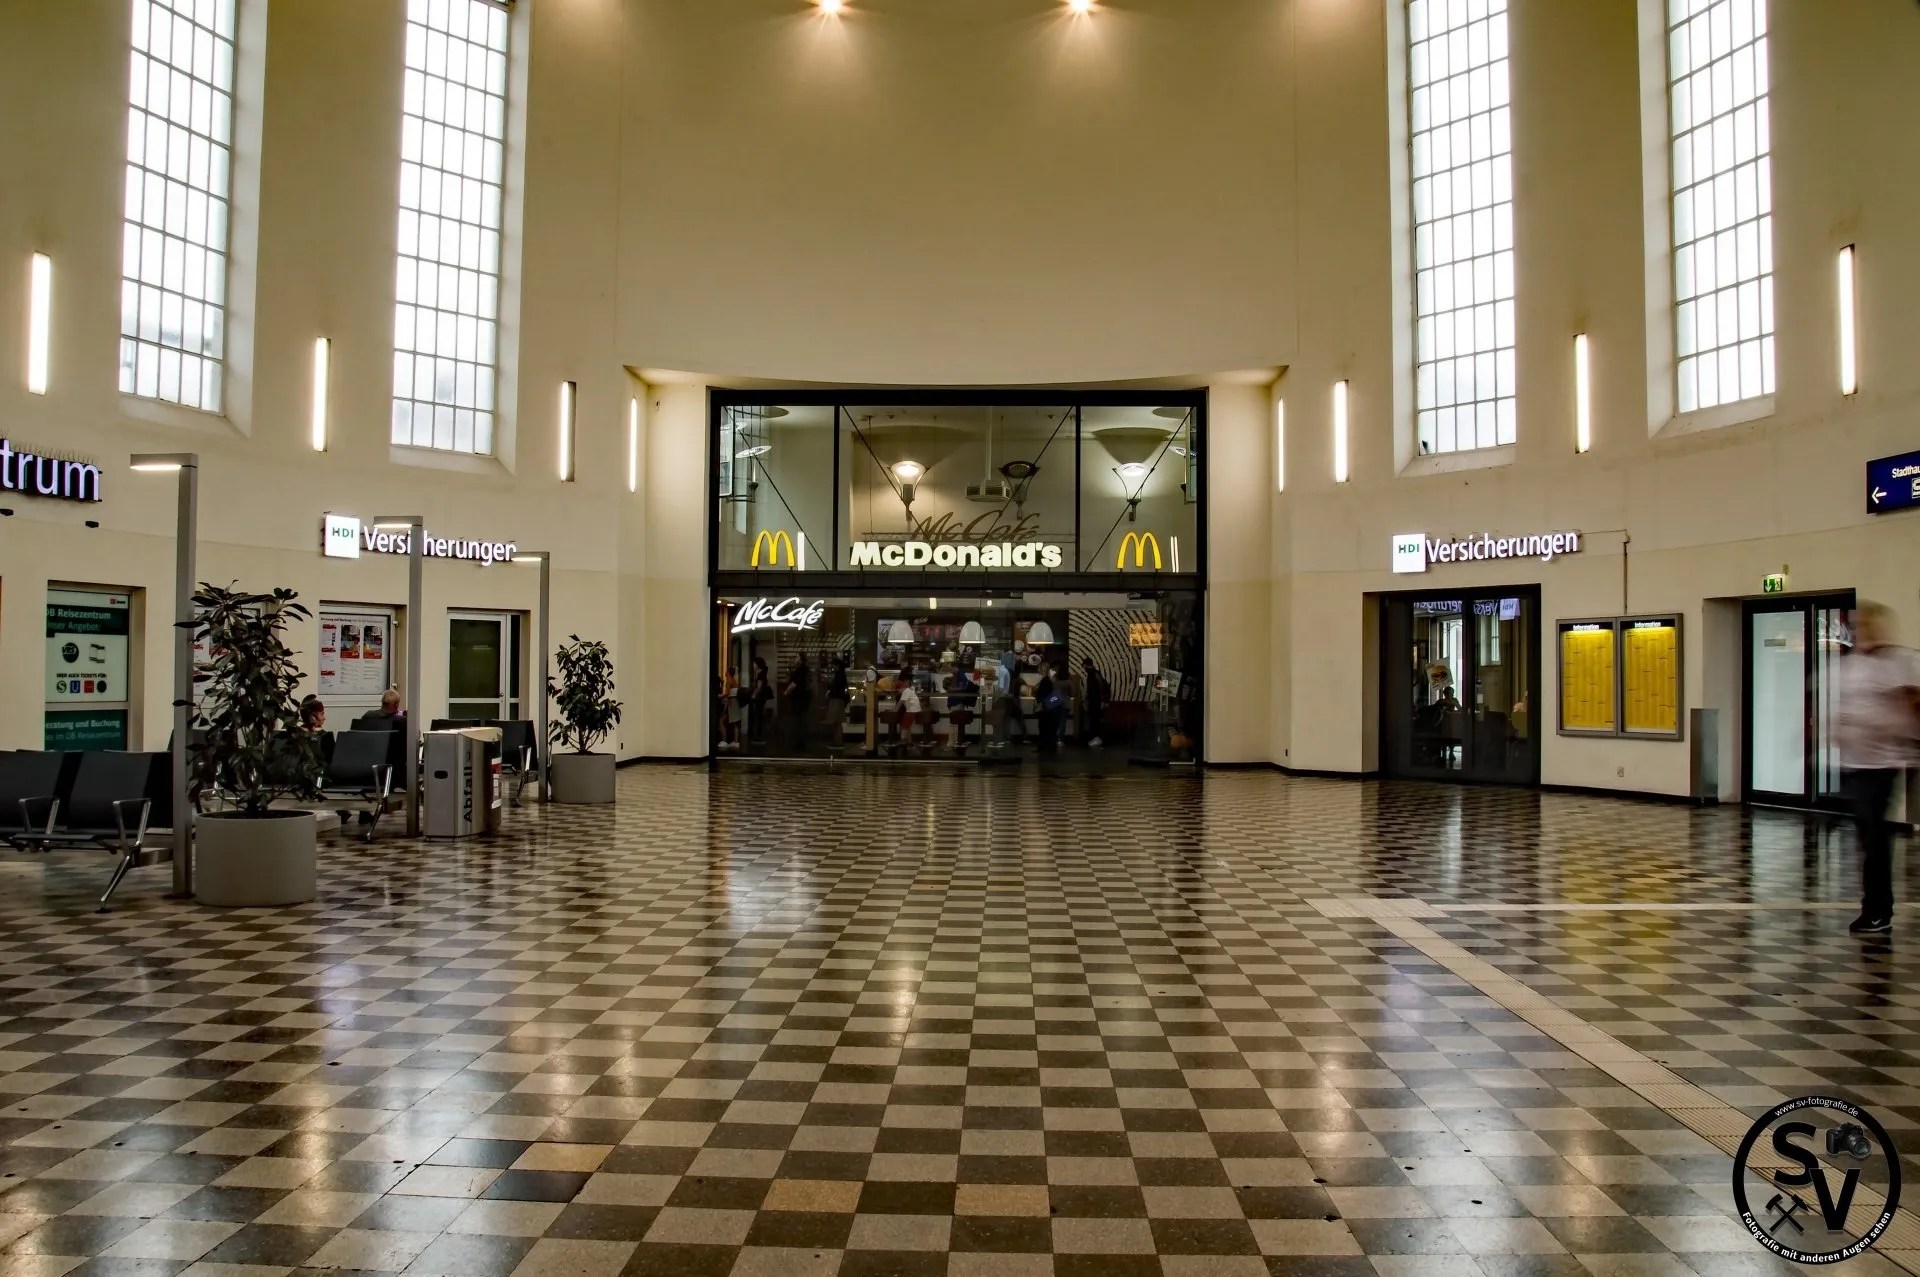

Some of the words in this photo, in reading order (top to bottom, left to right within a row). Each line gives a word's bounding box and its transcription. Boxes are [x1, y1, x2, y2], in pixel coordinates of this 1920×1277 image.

[0, 439, 99, 501] trum
[332, 526, 354, 539] HDI
[364, 525, 517, 567] Versiherungen
[850, 541, 1063, 568] McDonald's
[1398, 543, 1420, 554] HDI
[1426, 532, 1578, 562] Versicherungen
[57, 608, 112, 619] Reisezentrum
[733, 597, 825, 631] McCafé
[464, 765, 473, 824] Abfall
